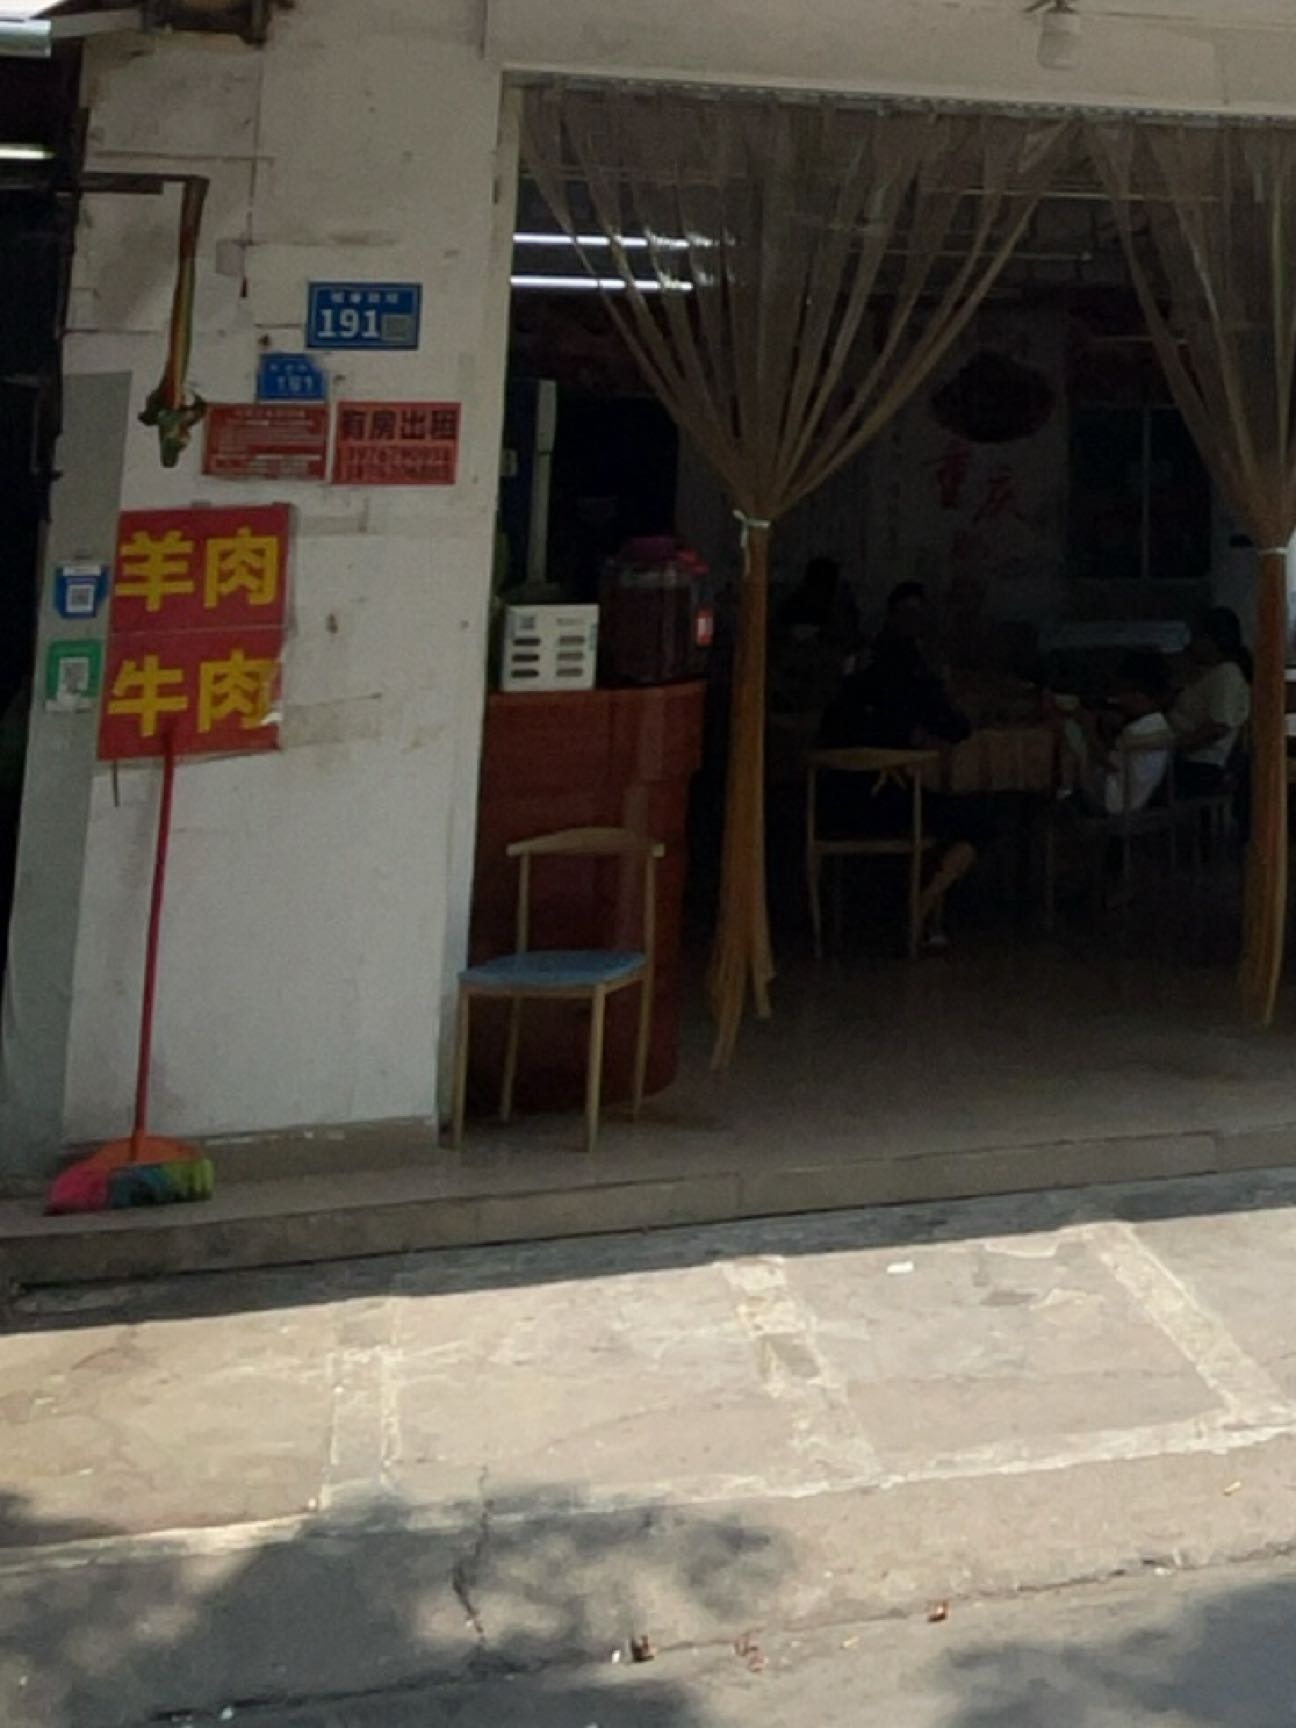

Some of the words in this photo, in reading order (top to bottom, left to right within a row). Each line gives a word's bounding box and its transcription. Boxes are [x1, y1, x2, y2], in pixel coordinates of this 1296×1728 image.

[317, 308, 380, 339] 191
[114, 526, 280, 612] 羊肉
[107, 648, 282, 738] 牛肉
